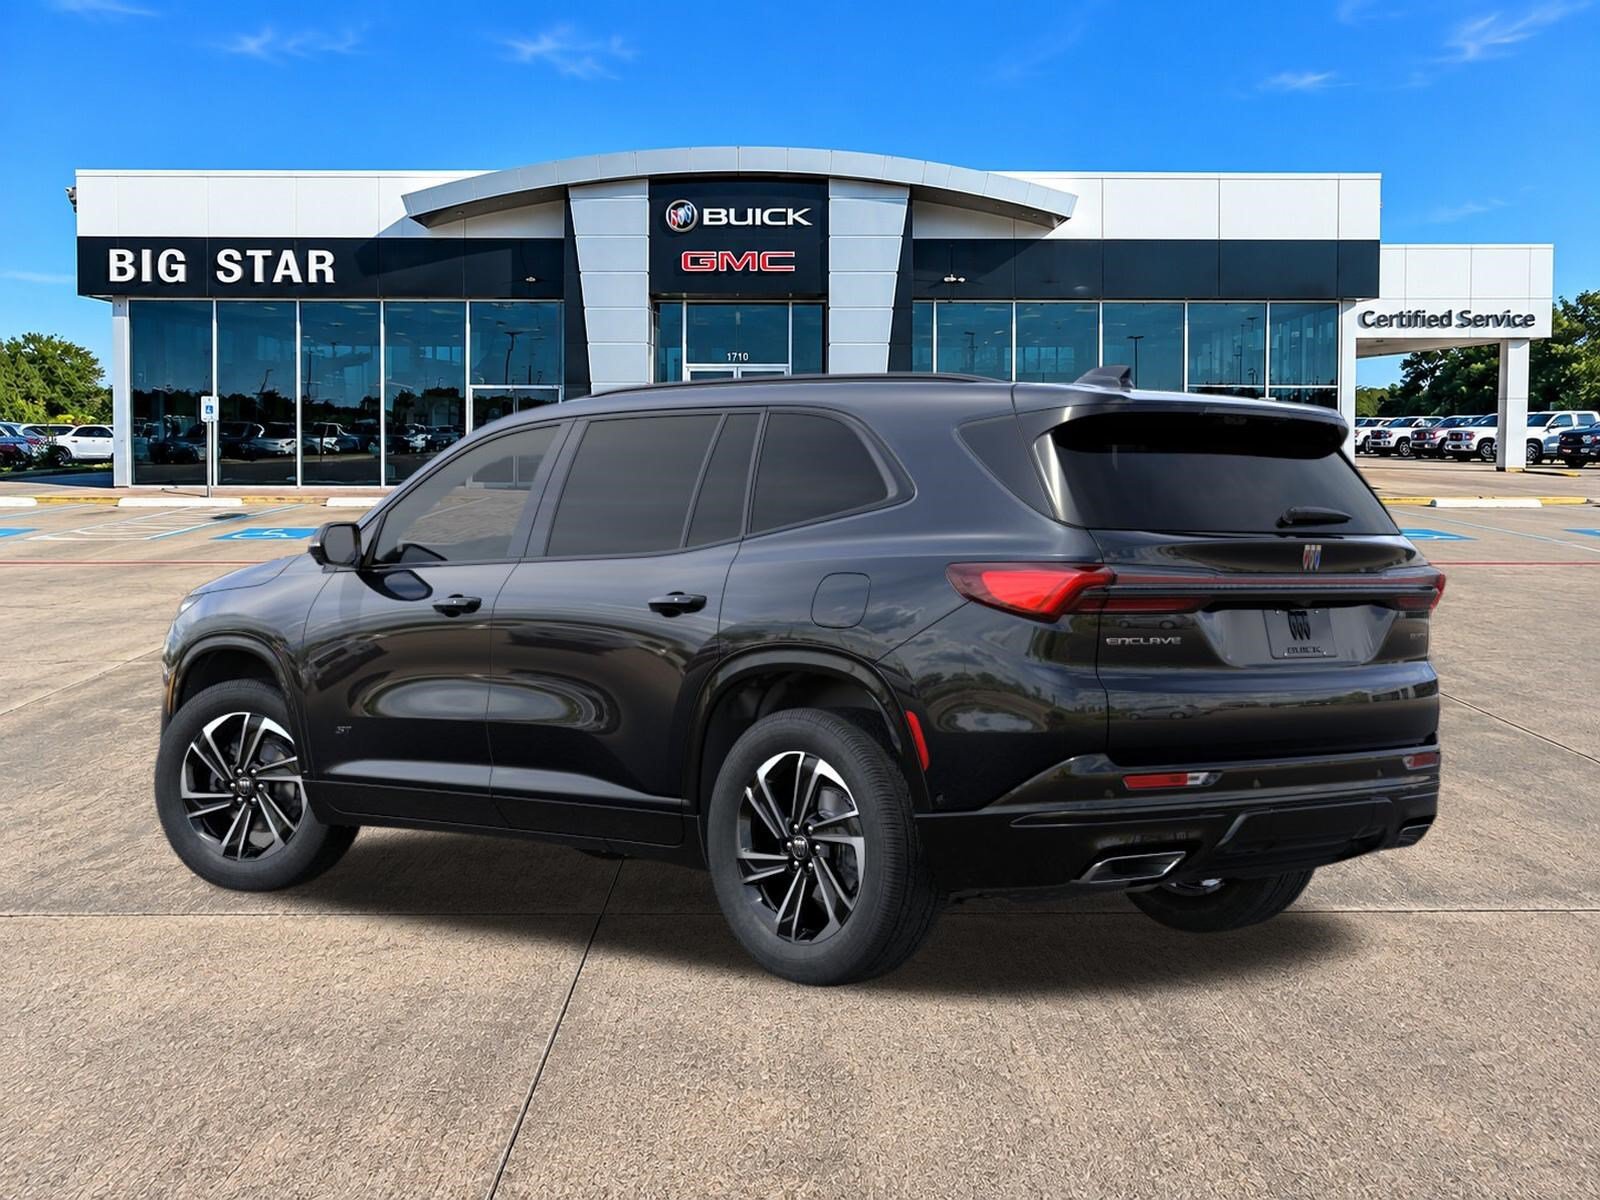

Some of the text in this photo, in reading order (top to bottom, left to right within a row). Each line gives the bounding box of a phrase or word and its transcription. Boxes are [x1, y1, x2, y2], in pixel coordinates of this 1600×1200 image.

[702, 207, 813, 226] BUICK
[108, 248, 336, 284] BIG STAR
[681, 250, 795, 272] GMC
[1359, 309, 1536, 328] Certified Service
[727, 352, 749, 361] 1710
[1105, 636, 1182, 646] ENCLAVE
